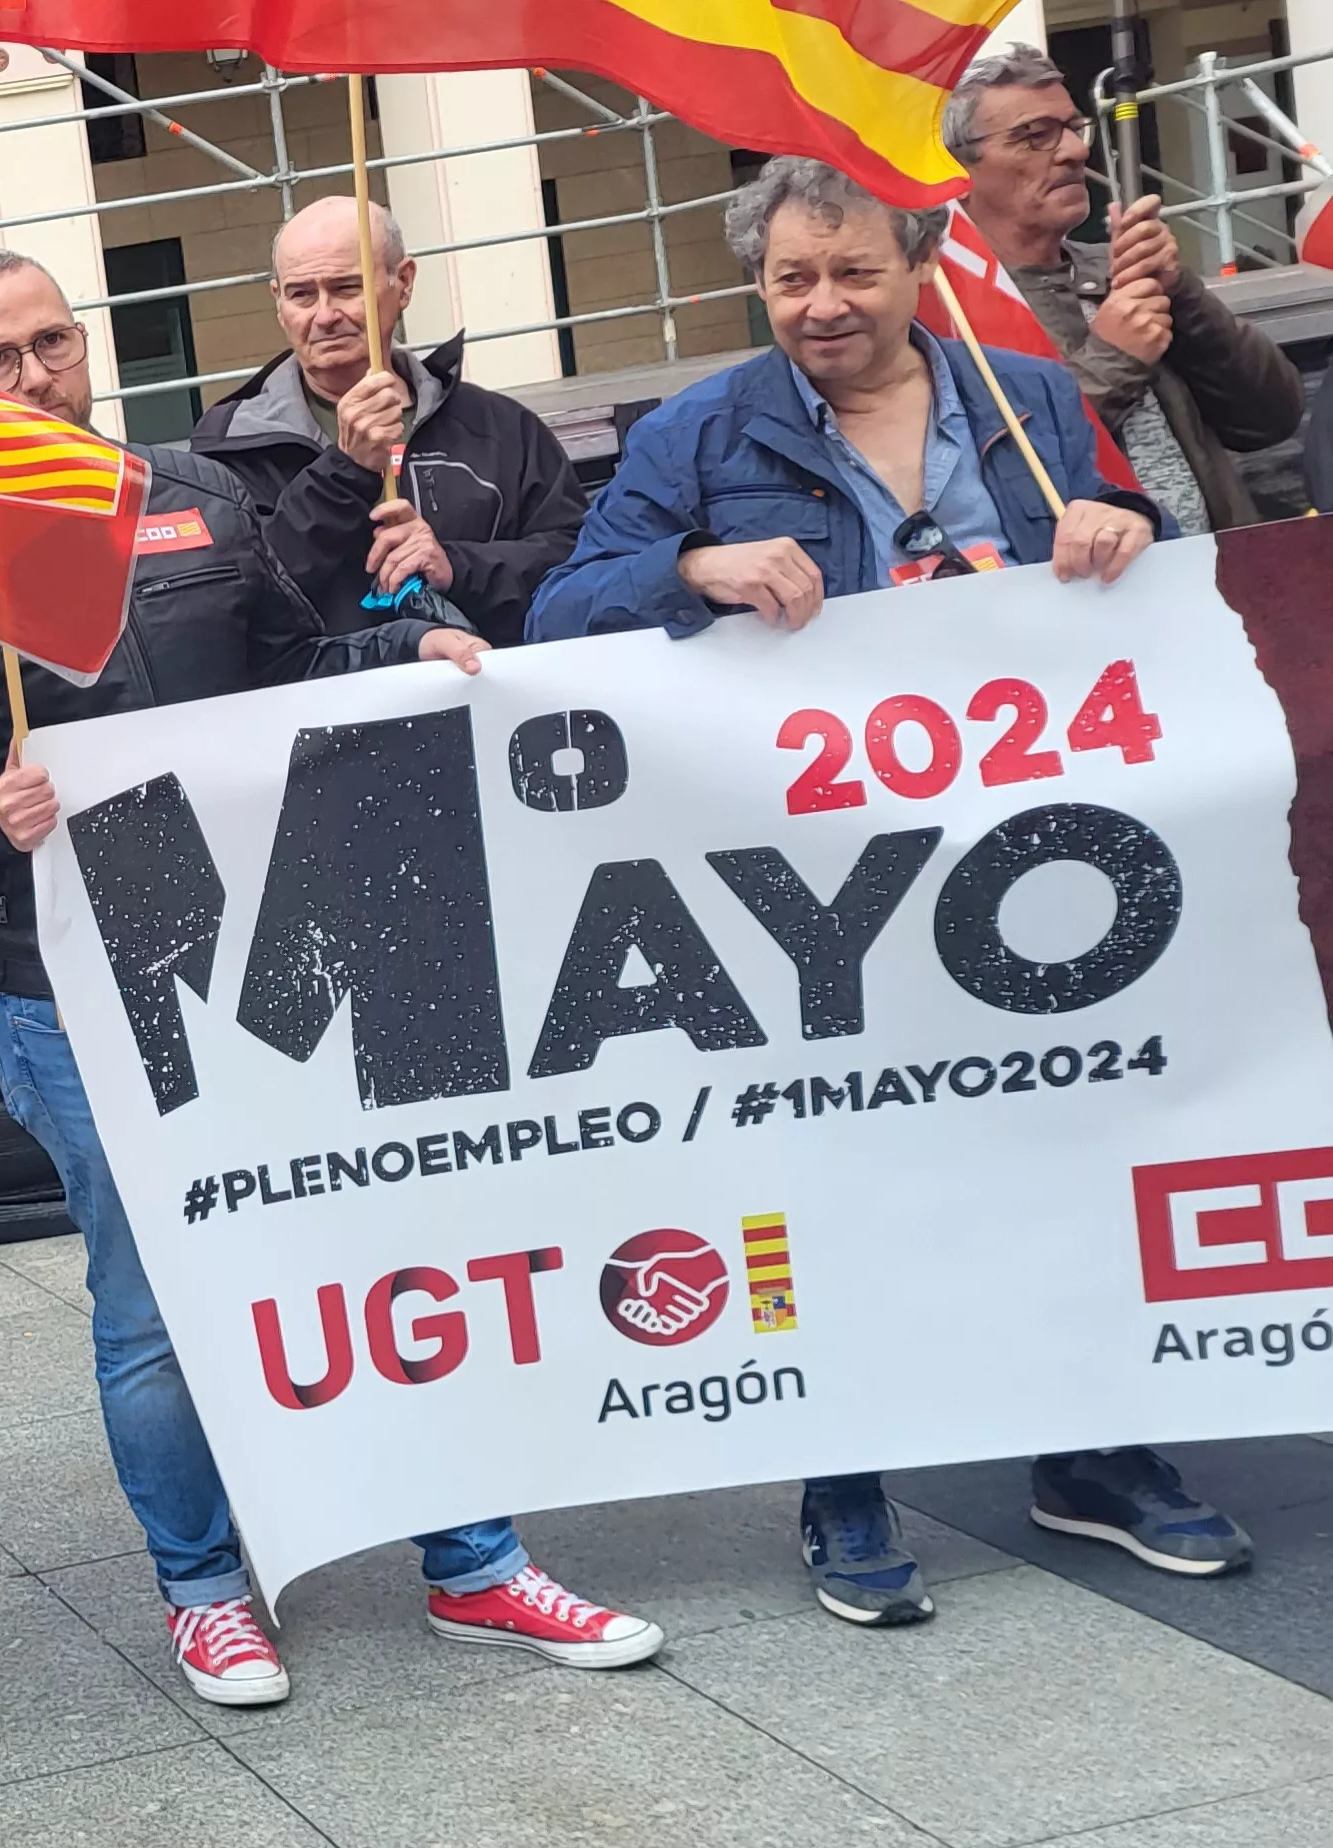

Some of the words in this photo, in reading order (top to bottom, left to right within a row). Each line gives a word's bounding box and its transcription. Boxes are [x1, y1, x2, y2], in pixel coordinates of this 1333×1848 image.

[775, 659, 1163, 815] 2024
[184, 1101, 662, 1224] #PLENOEMPLEO
[732, 1035, 1168, 1126] #1MAYO2024
[251, 1246, 564, 1410] UGT
[597, 1359, 806, 1422] Aragón
